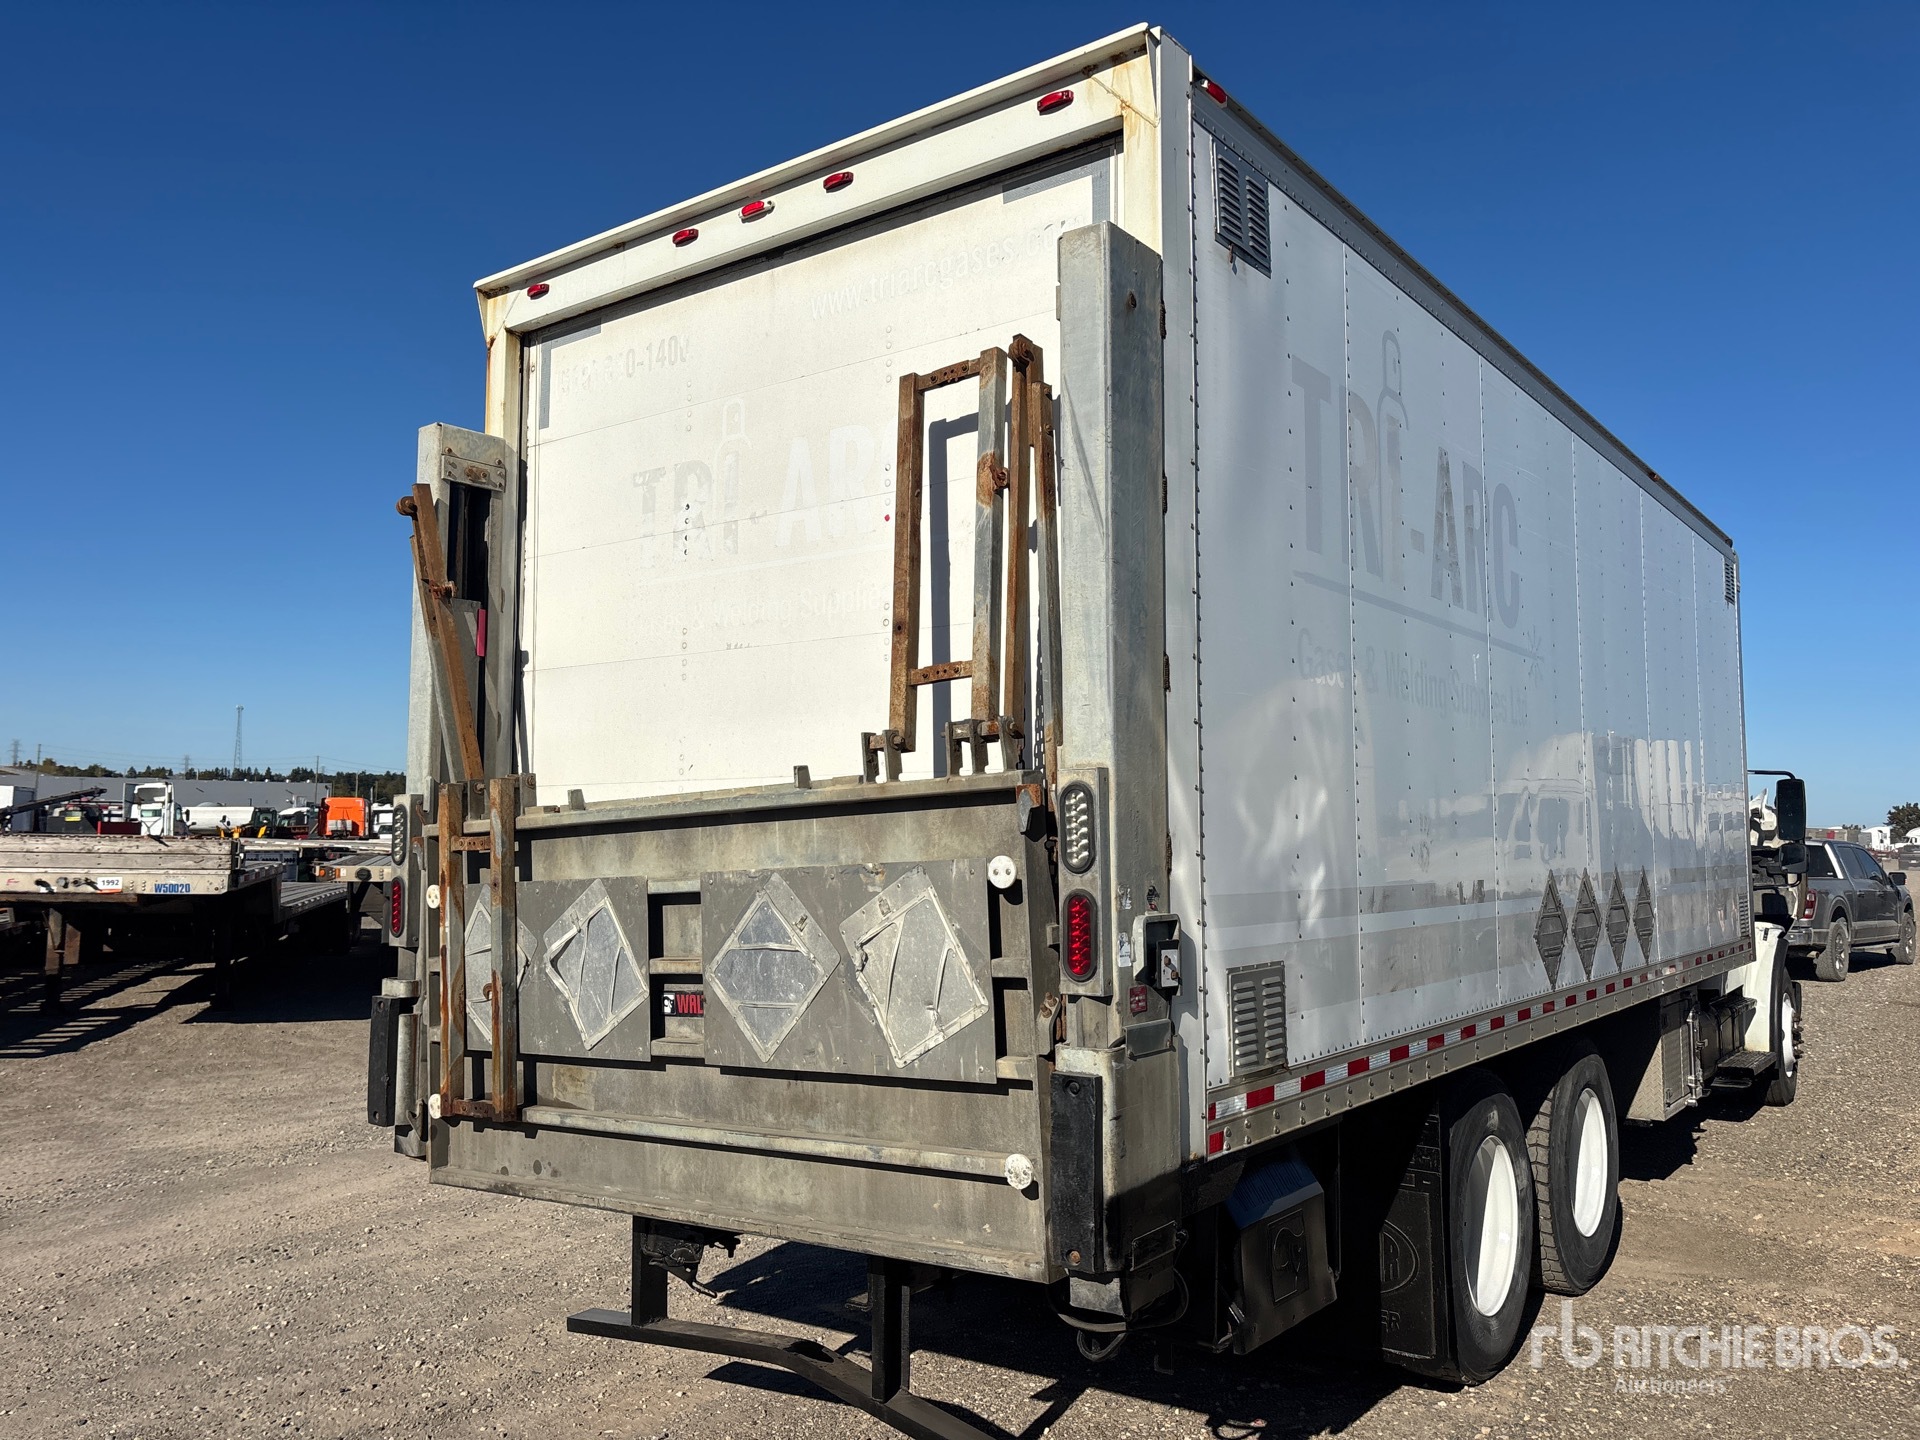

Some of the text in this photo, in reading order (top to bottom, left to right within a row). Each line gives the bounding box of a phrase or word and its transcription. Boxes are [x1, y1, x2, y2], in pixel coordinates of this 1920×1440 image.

[1291, 354, 1519, 628] TRI-ARC
[1364, 645, 1379, 694] &
[1384, 650, 1448, 719] Welding
[154, 883, 191, 893] W50020
[675, 993, 704, 1014] WAL
